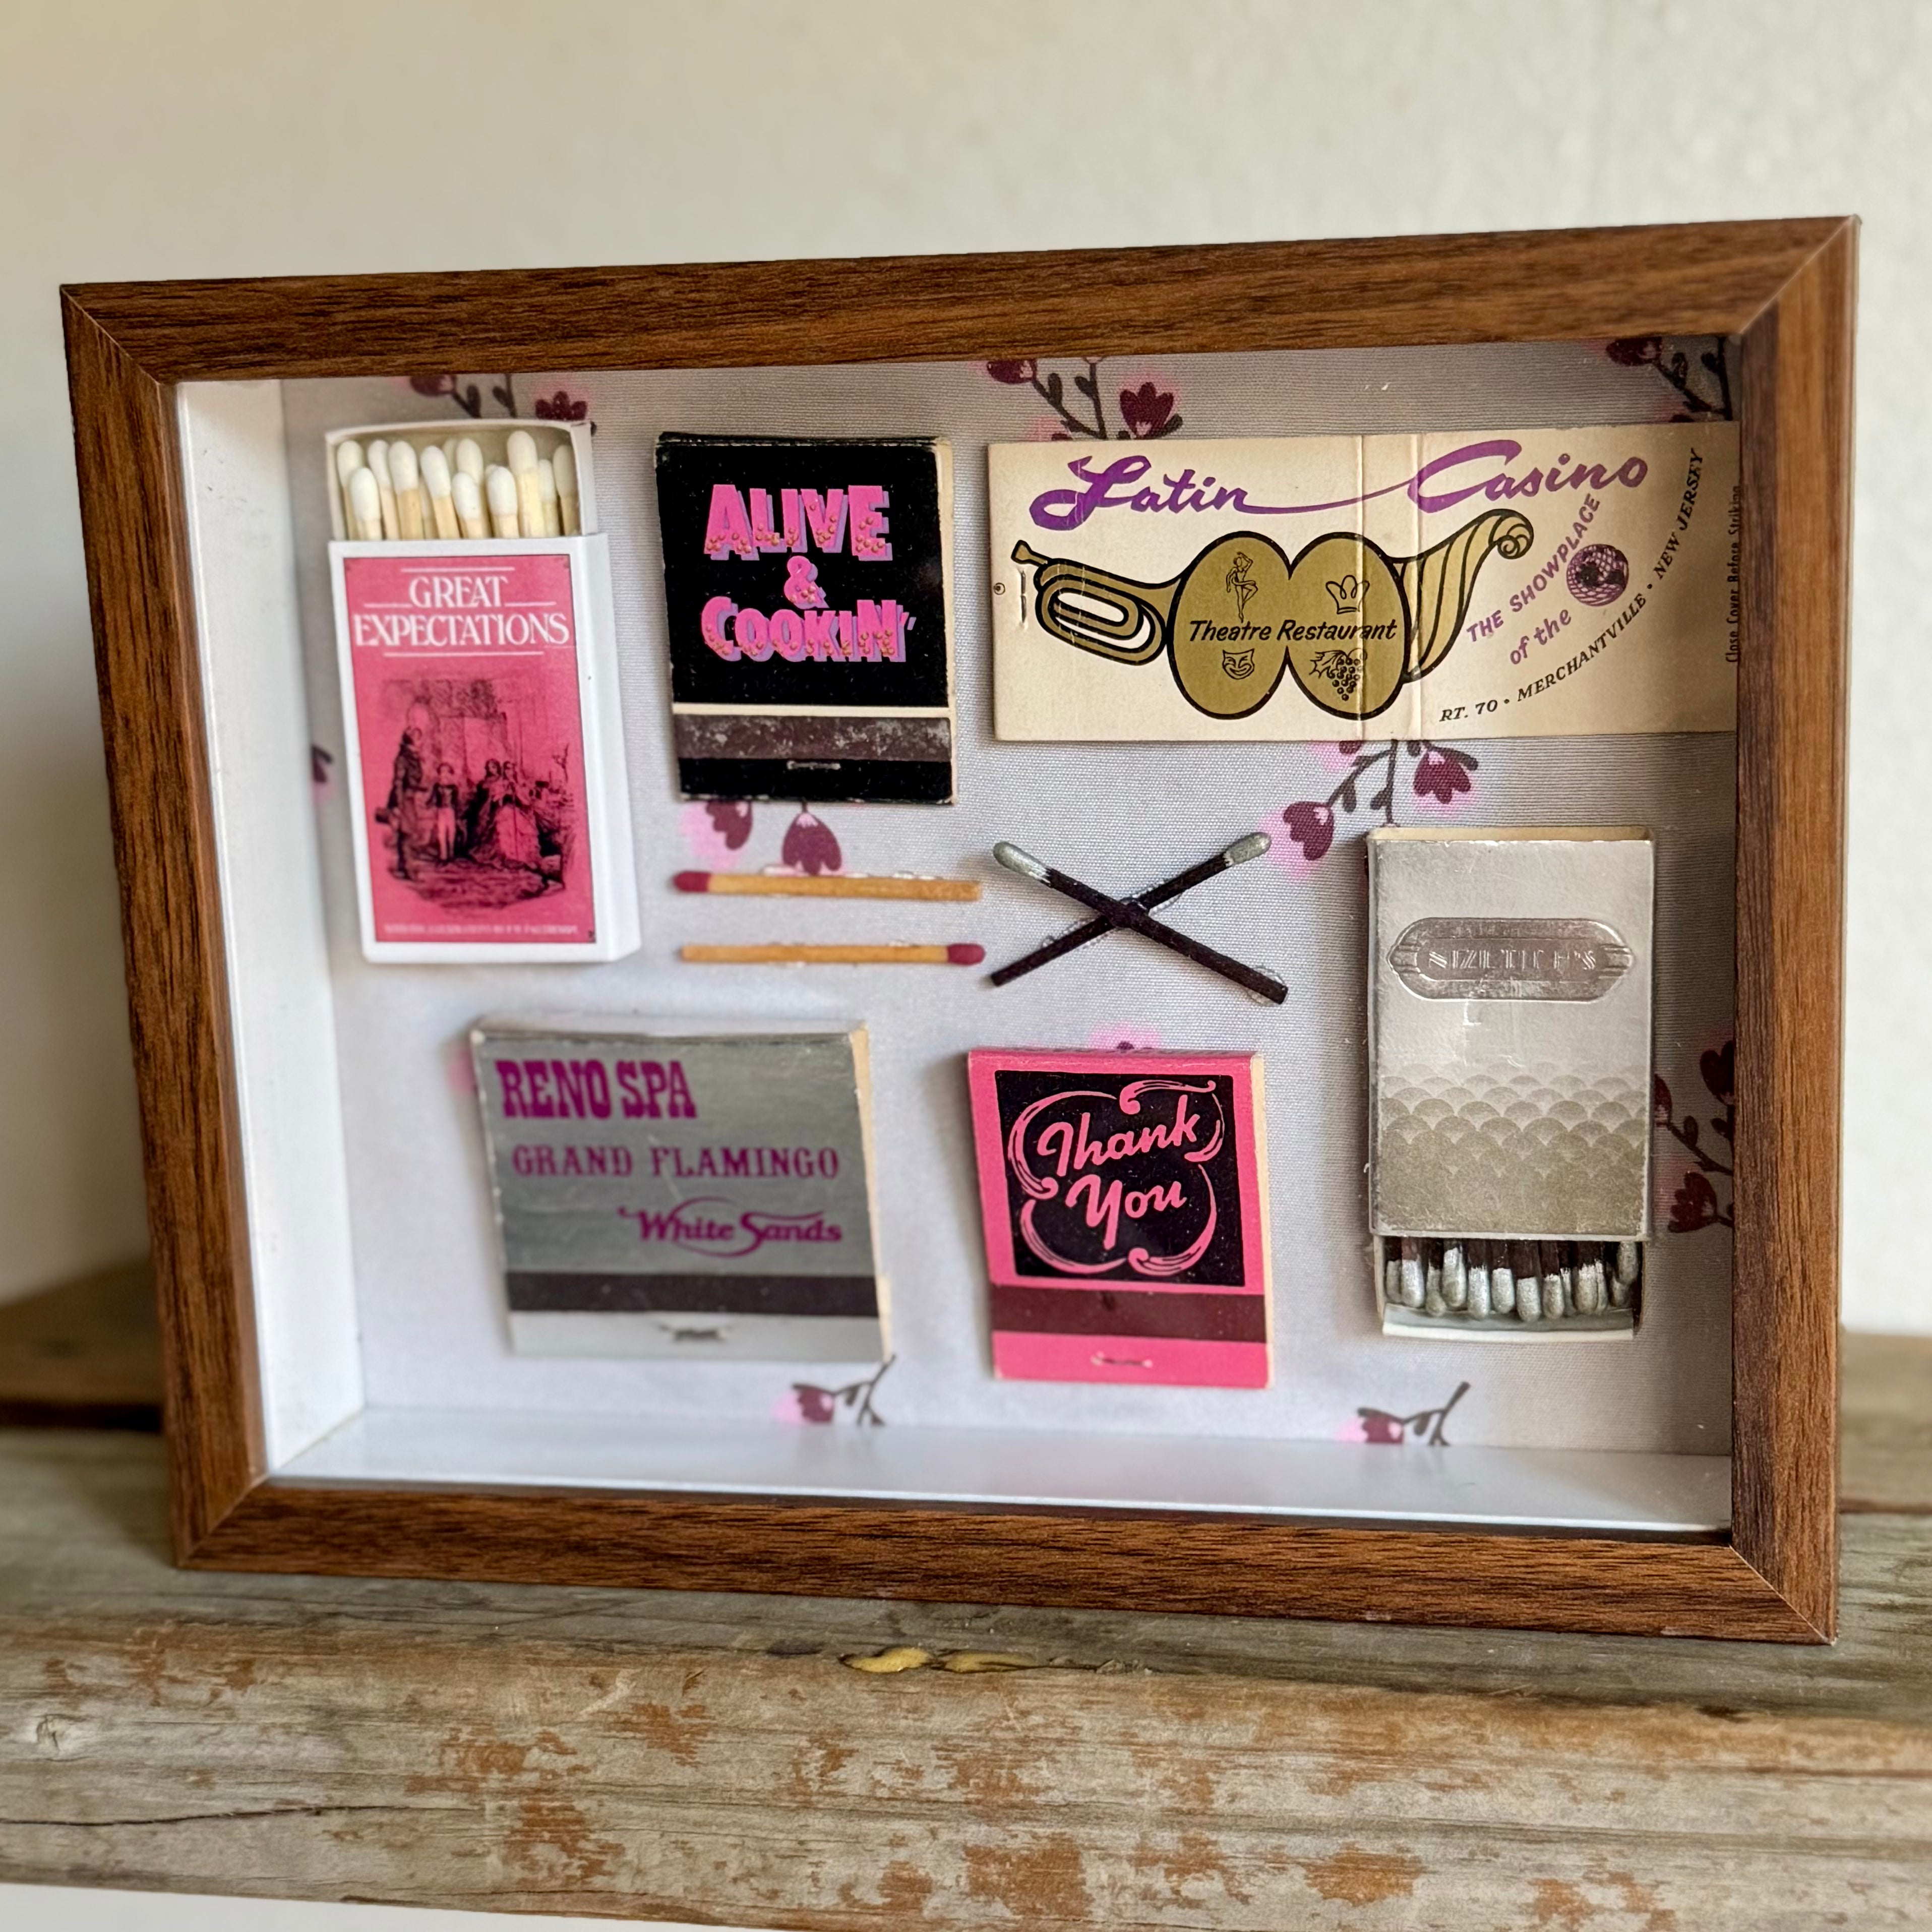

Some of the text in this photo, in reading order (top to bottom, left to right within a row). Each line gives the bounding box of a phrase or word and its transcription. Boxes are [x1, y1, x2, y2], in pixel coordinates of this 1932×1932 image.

[1029, 439, 1648, 531] Latin Casino
[703, 485, 893, 561] ALIVE
[409, 577, 508, 608] GREAT
[783, 555, 829, 609] &
[1439, 448, 1704, 721] RT. 70 MERCHANTVILLE NEW JERSEY
[1467, 494, 1600, 642] THE SHOWPLACE
[354, 613, 570, 646] EXPECTATIONS
[1189, 620, 1398, 642] Theatre Restaurant
[1510, 608, 1572, 665] of the
[496, 1060, 698, 1119] RENO SPA
[513, 1146, 839, 1178] GRAND FLAMINGO
[1036, 1095, 1200, 1177] Thank
[740, 1210, 842, 1254] Sands
[1066, 1175, 1187, 1250] You
